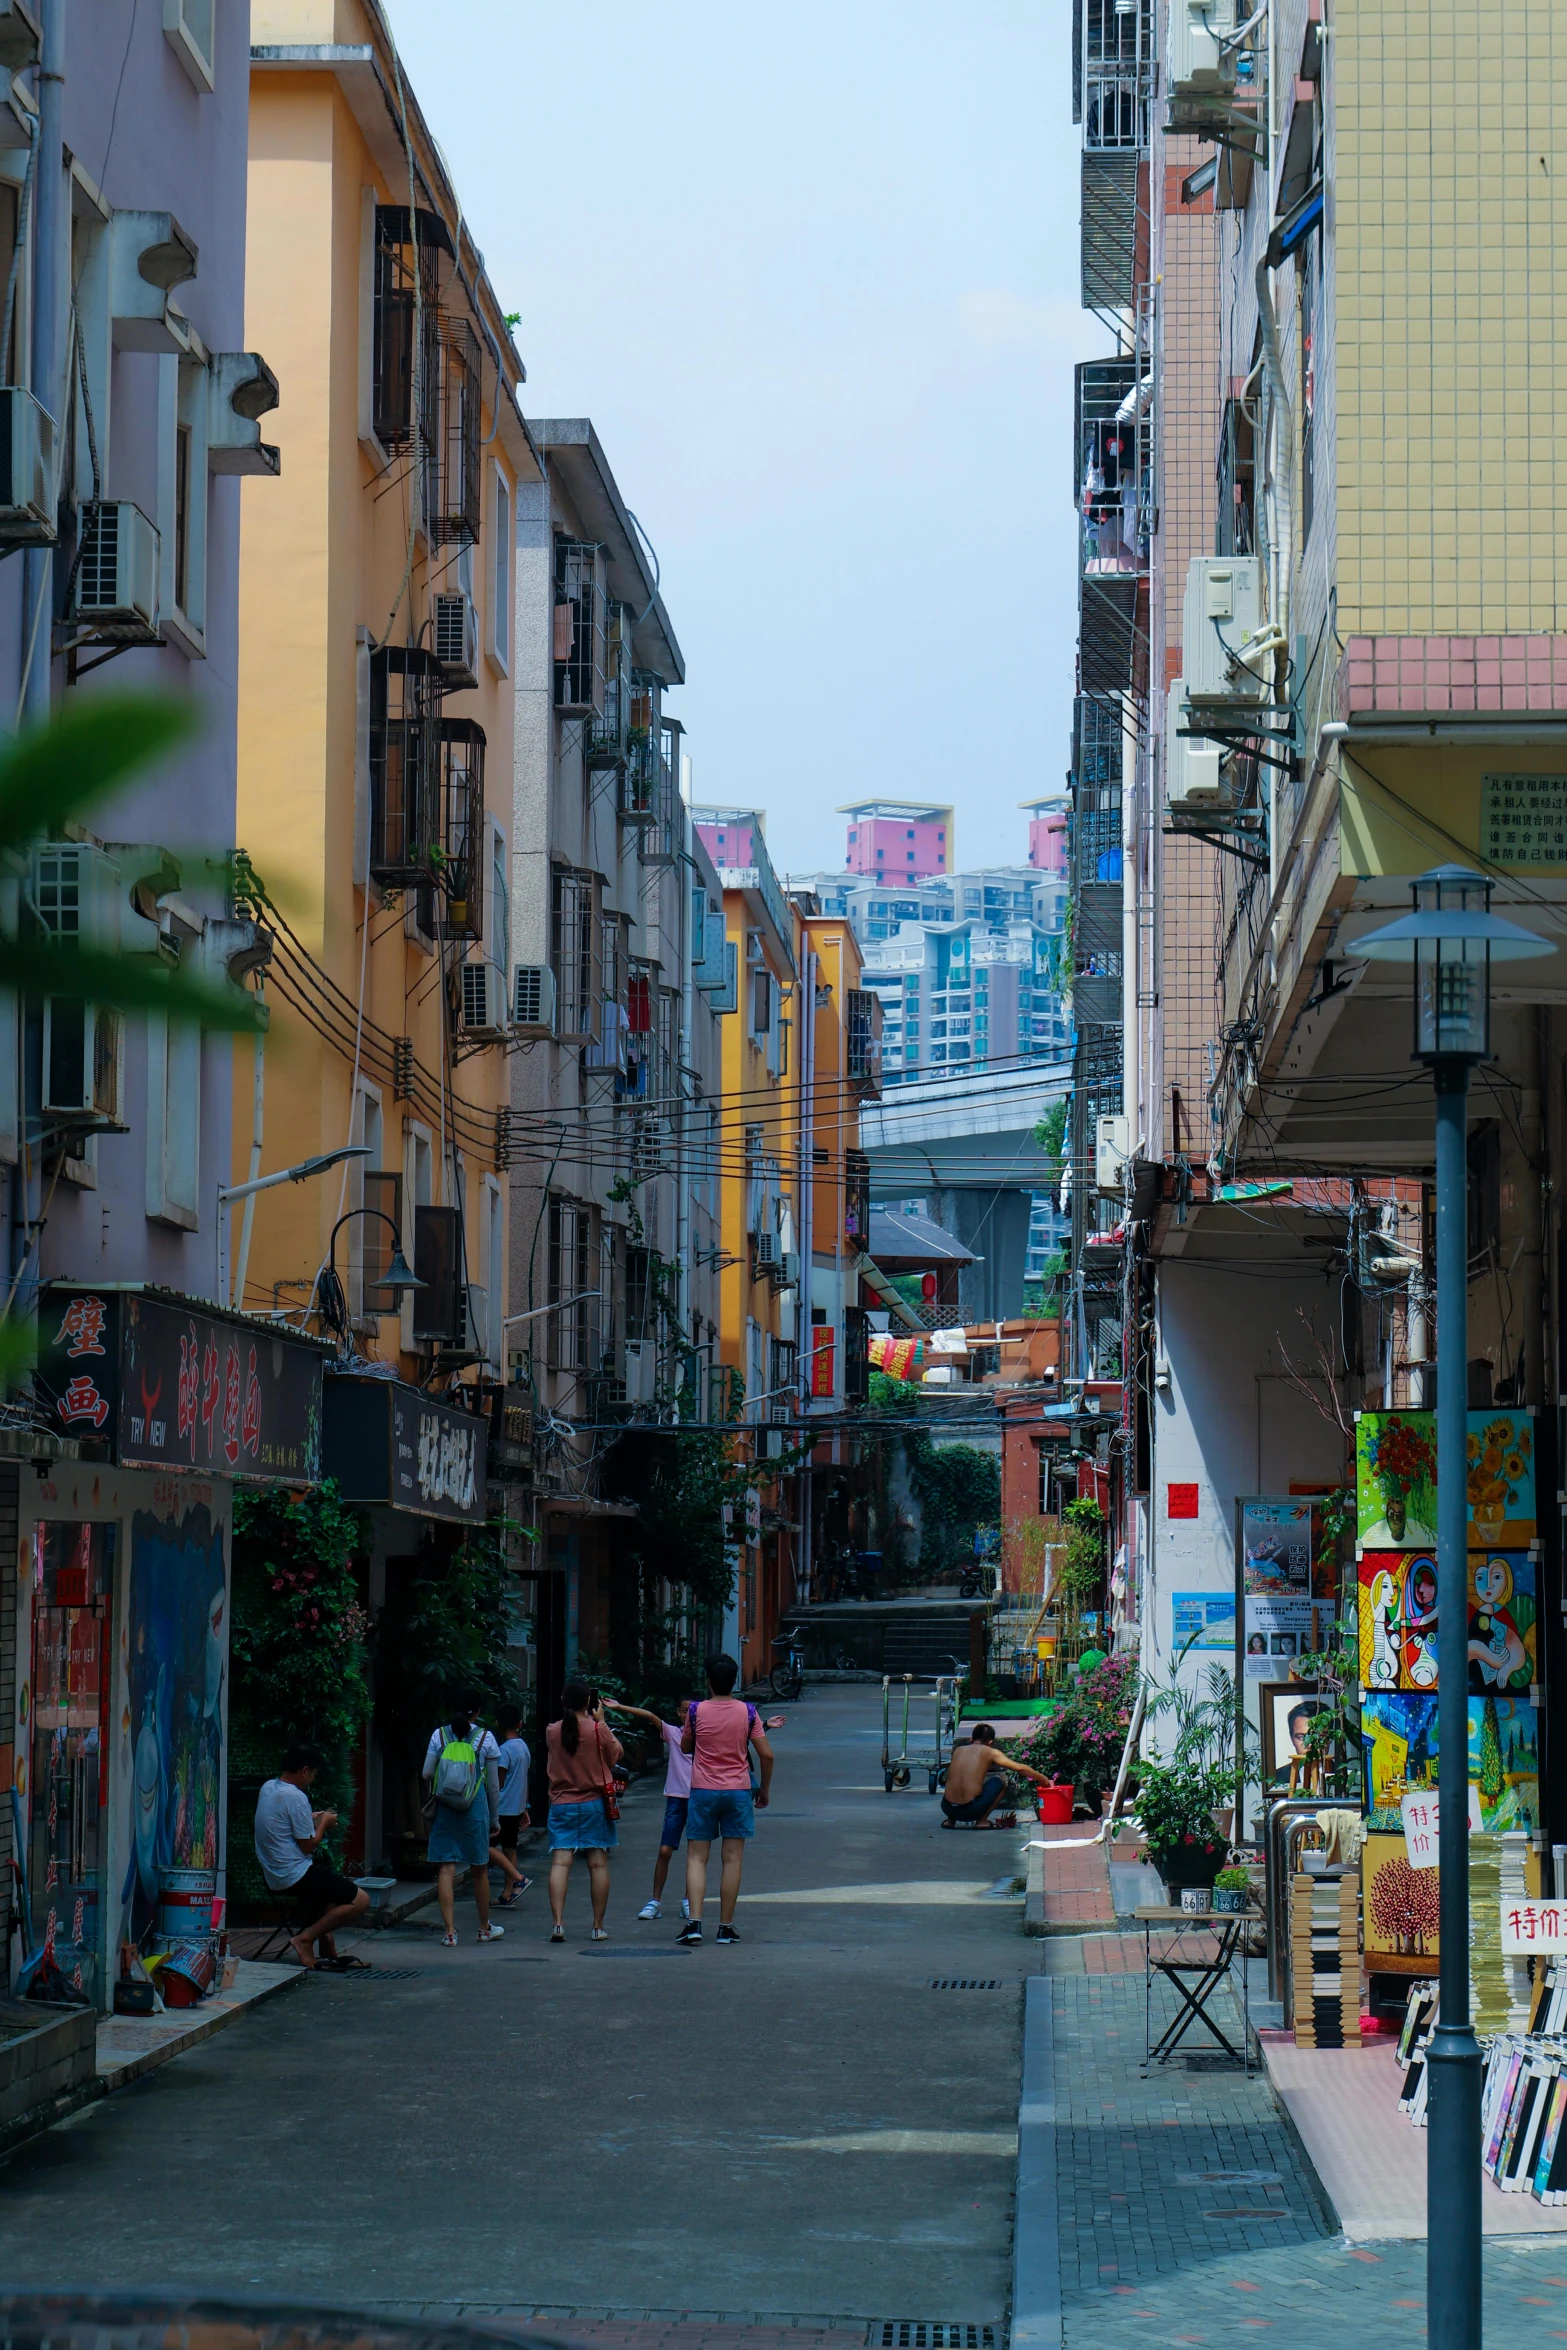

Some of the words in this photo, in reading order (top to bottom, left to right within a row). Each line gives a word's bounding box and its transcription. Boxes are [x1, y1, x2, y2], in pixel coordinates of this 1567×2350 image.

[1490, 814, 1567, 826] 签署租赁合同才
[1490, 831, 1564, 843] 谁签合同谁
[52, 1295, 109, 1428] 壁画
[178, 1318, 262, 1464] 醉牛壁画
[130, 1417, 144, 1445] TRY
[150, 1420, 167, 1447] NEW
[1408, 1805, 1430, 1854] 特价
[1184, 1896, 1196, 1910] 66
[1508, 1906, 1567, 1940] 特价
